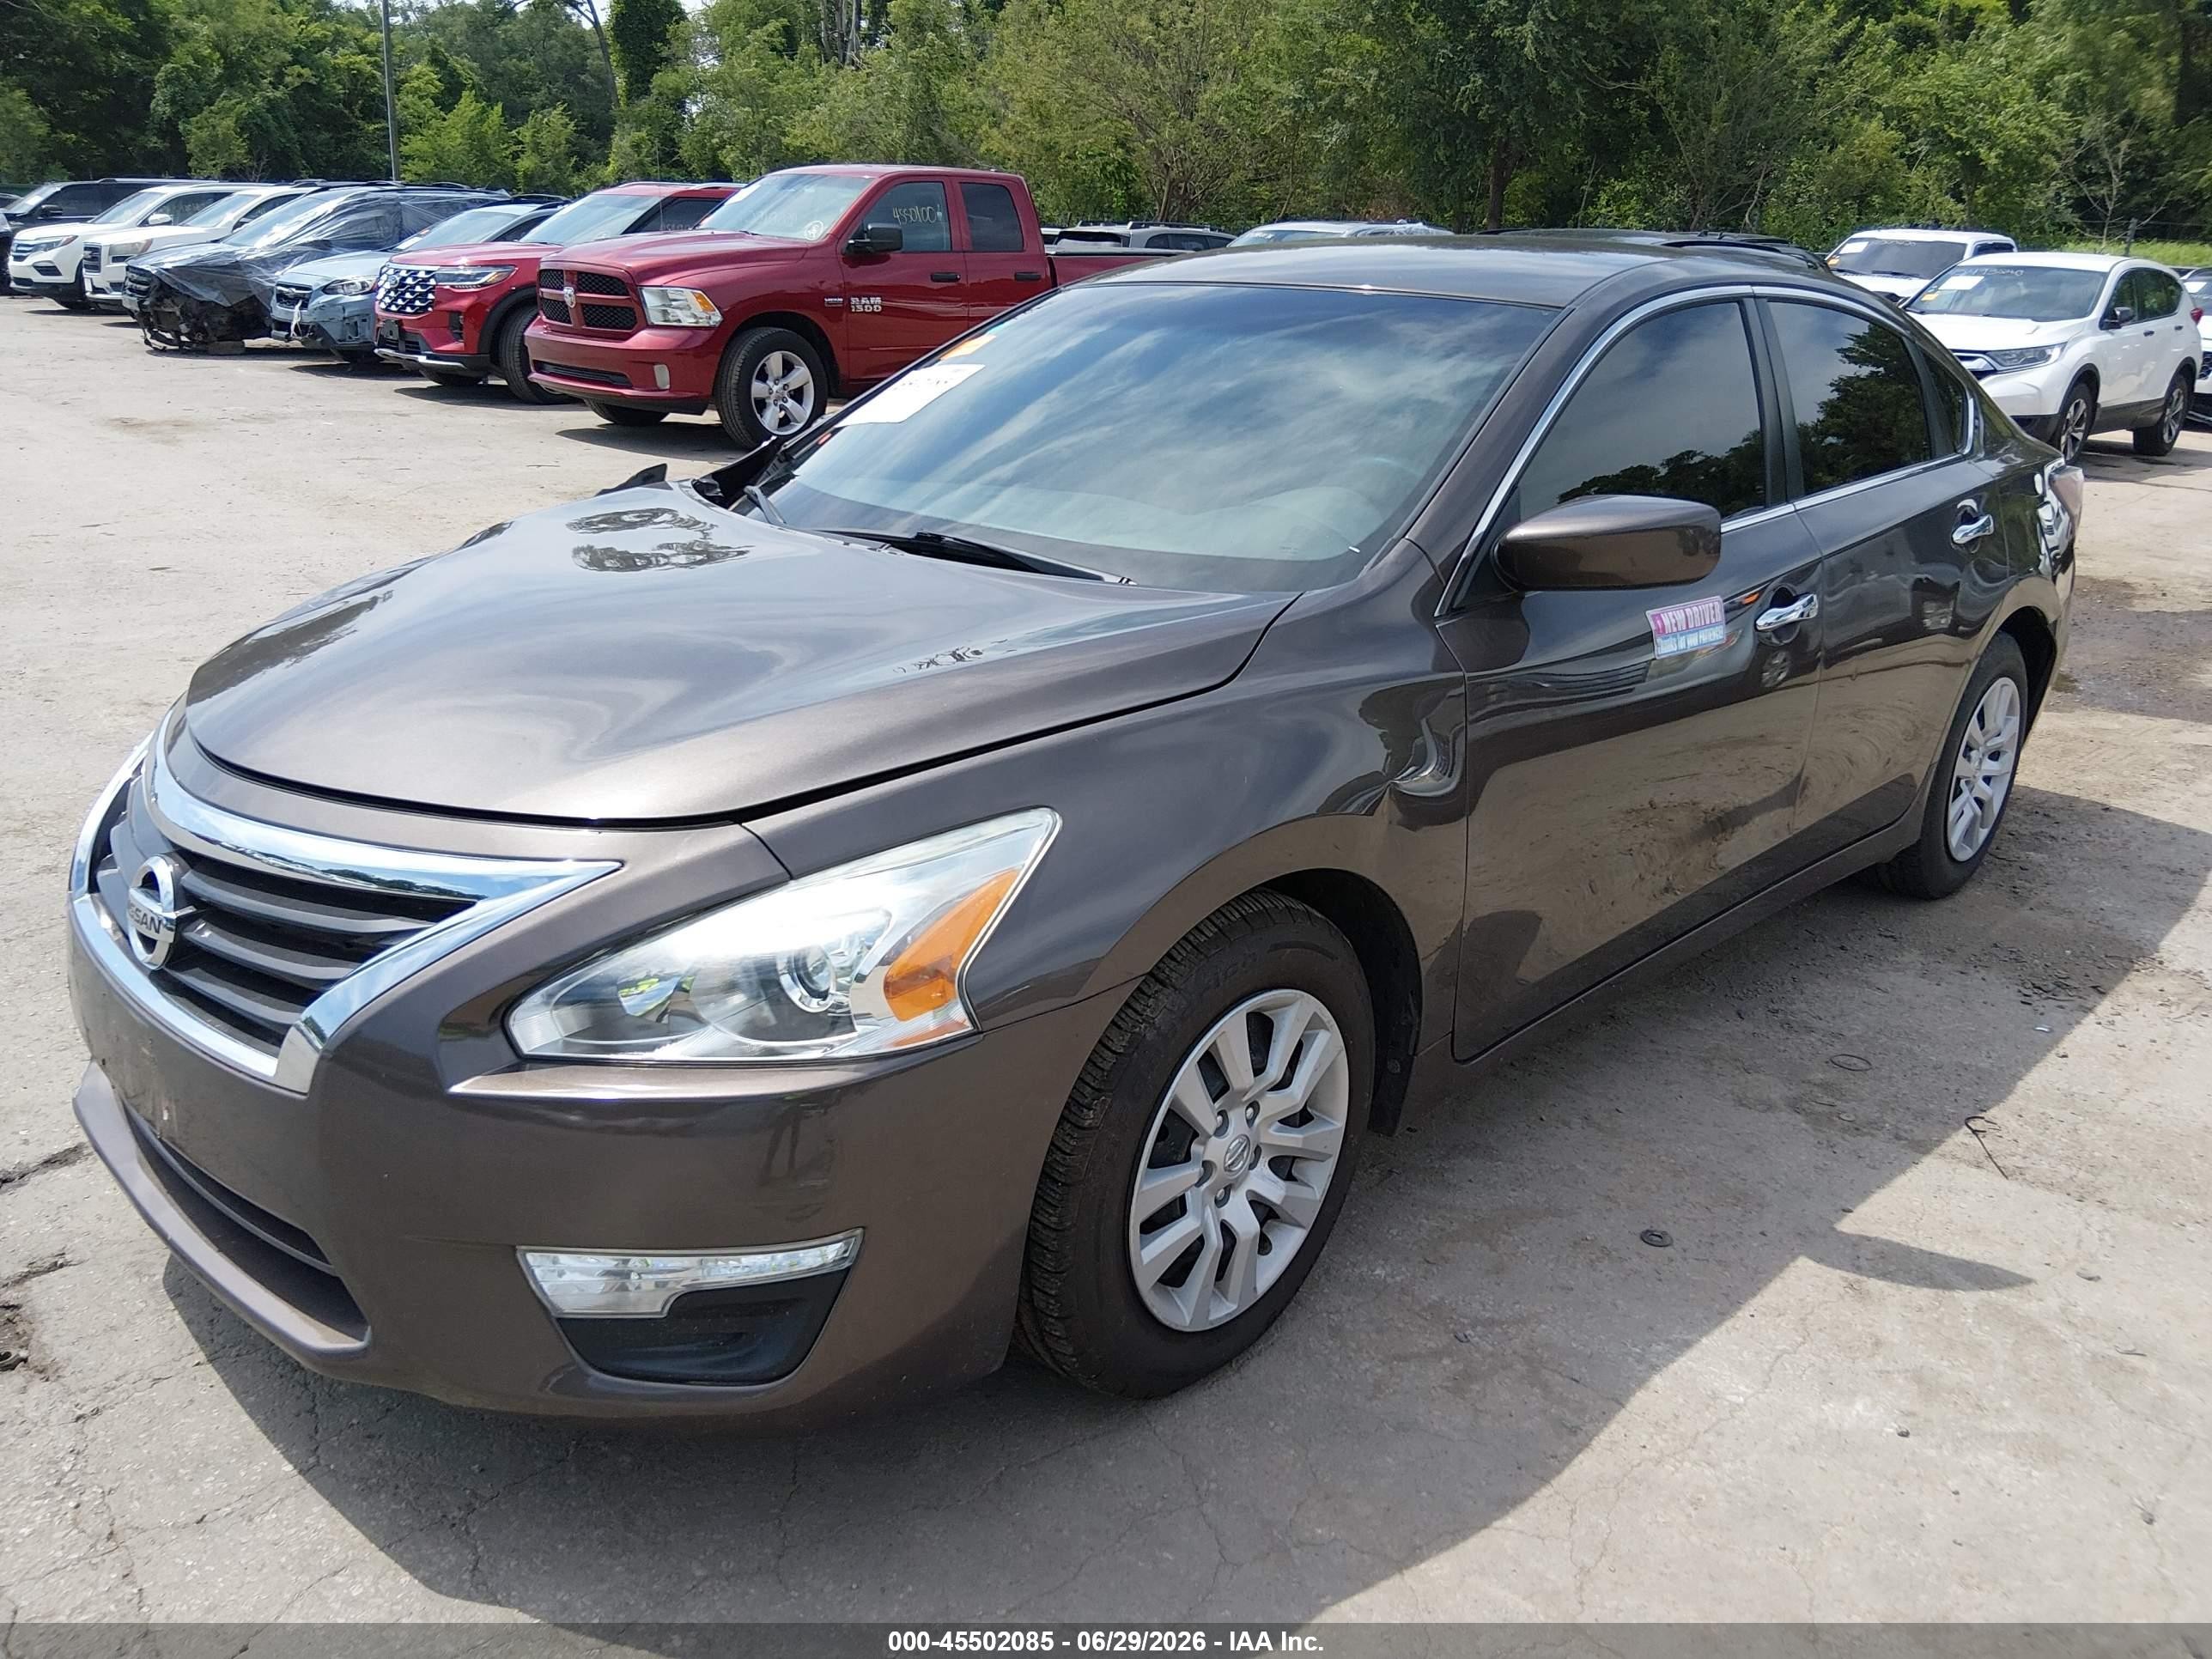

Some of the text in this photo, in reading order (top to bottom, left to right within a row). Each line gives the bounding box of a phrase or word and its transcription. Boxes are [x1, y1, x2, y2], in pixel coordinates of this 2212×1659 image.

[850, 296, 882, 305] RAM
[851, 304, 883, 313] 1500
[1661, 601, 1723, 635] NEW DRIVER
[130, 902, 164, 935] SSAN
